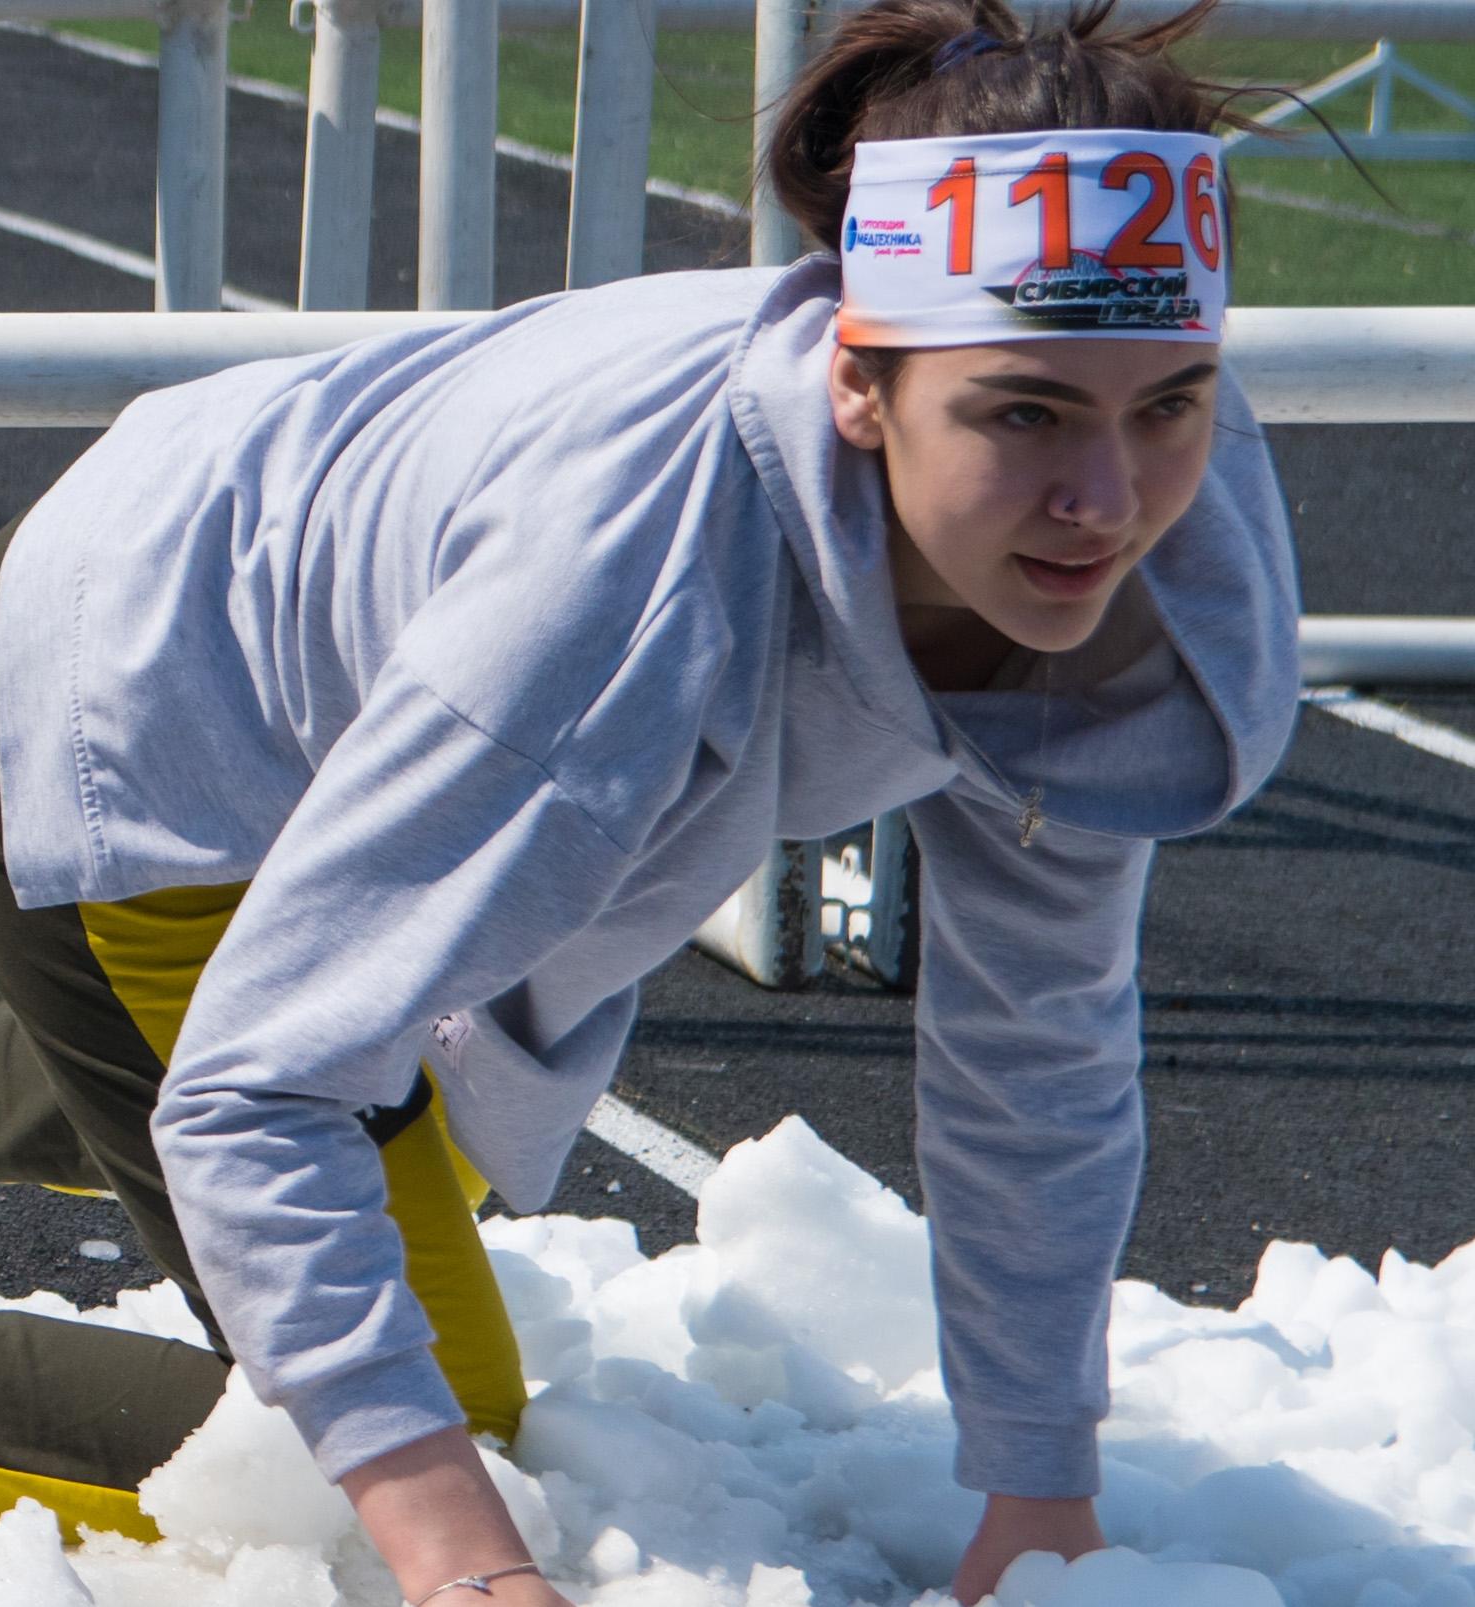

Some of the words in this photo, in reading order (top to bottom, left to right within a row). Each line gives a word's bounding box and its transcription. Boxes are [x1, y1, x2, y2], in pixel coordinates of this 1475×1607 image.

[926, 150, 1219, 275] 1126
[857, 232, 922, 247] МЕДТЕХНИКА
[1015, 271, 1187, 304] СИБИРСКИЙ
